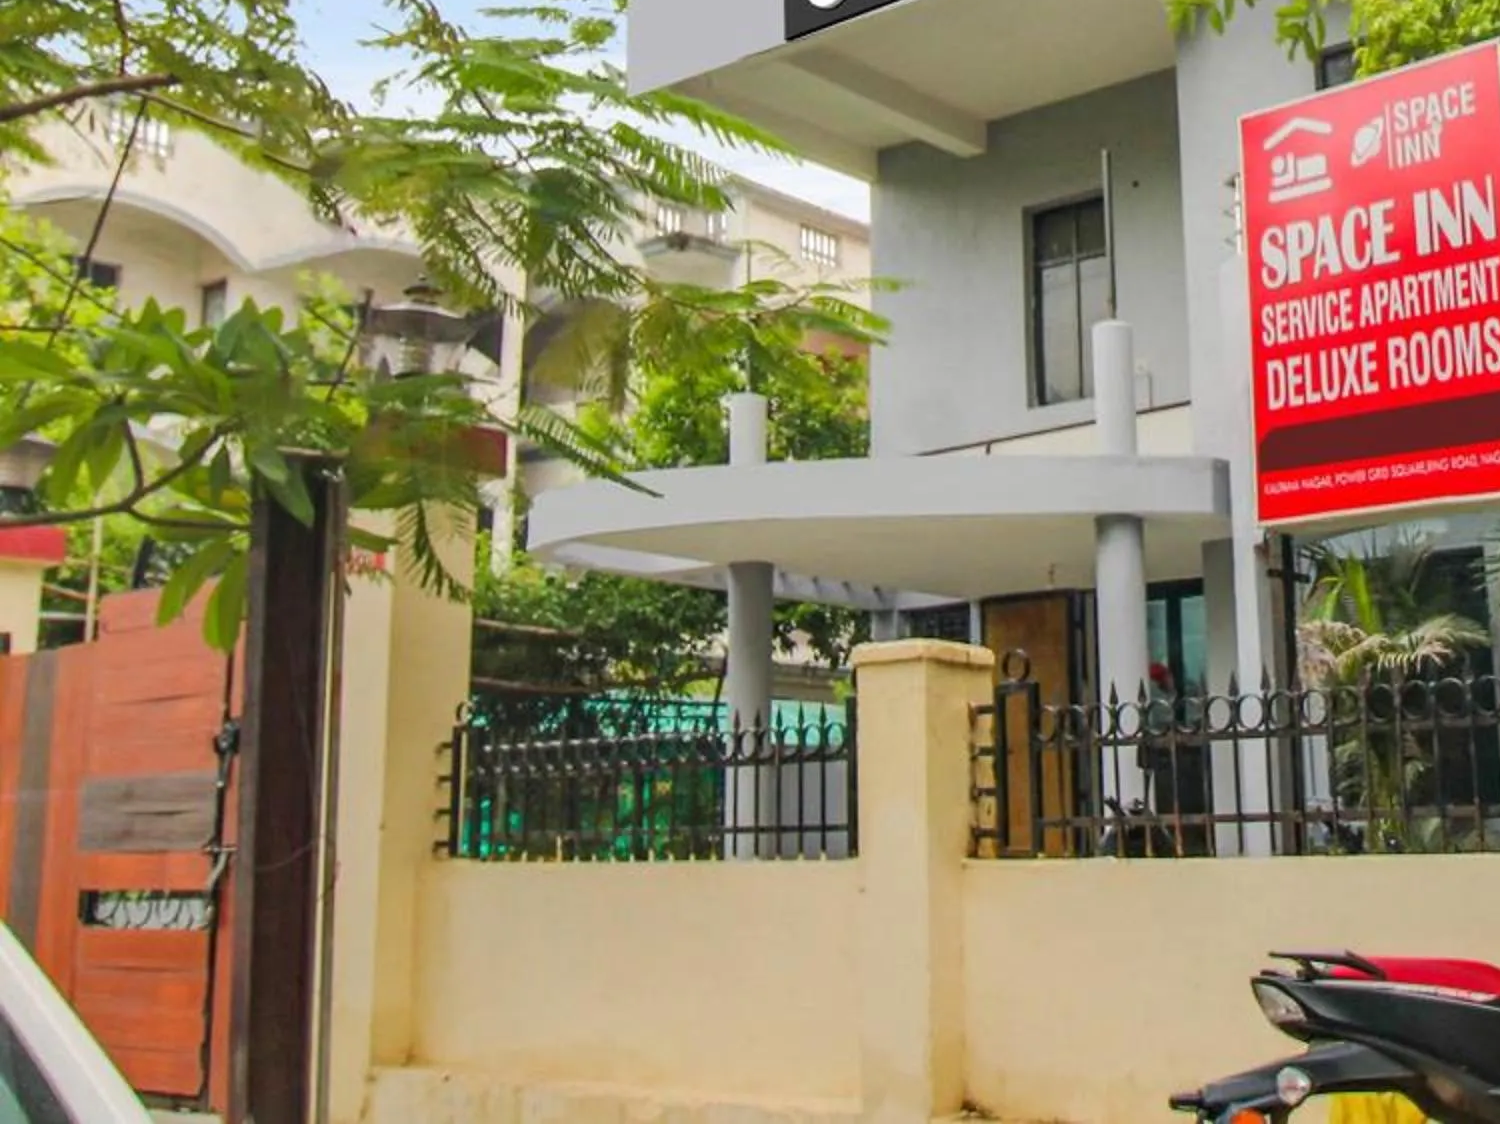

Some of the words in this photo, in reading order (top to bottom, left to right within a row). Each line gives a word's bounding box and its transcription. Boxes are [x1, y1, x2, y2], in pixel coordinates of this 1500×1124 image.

[1393, 82, 1476, 131] SPACE
[1395, 130, 1442, 168] INN
[1261, 199, 1400, 289] SPACE
[1413, 175, 1498, 256] INN
[1261, 287, 1353, 348] SERVICE
[1266, 340, 1379, 411] DELUXE
[1335, 470, 1367, 485] POWER
[1367, 466, 1389, 481] GRID
